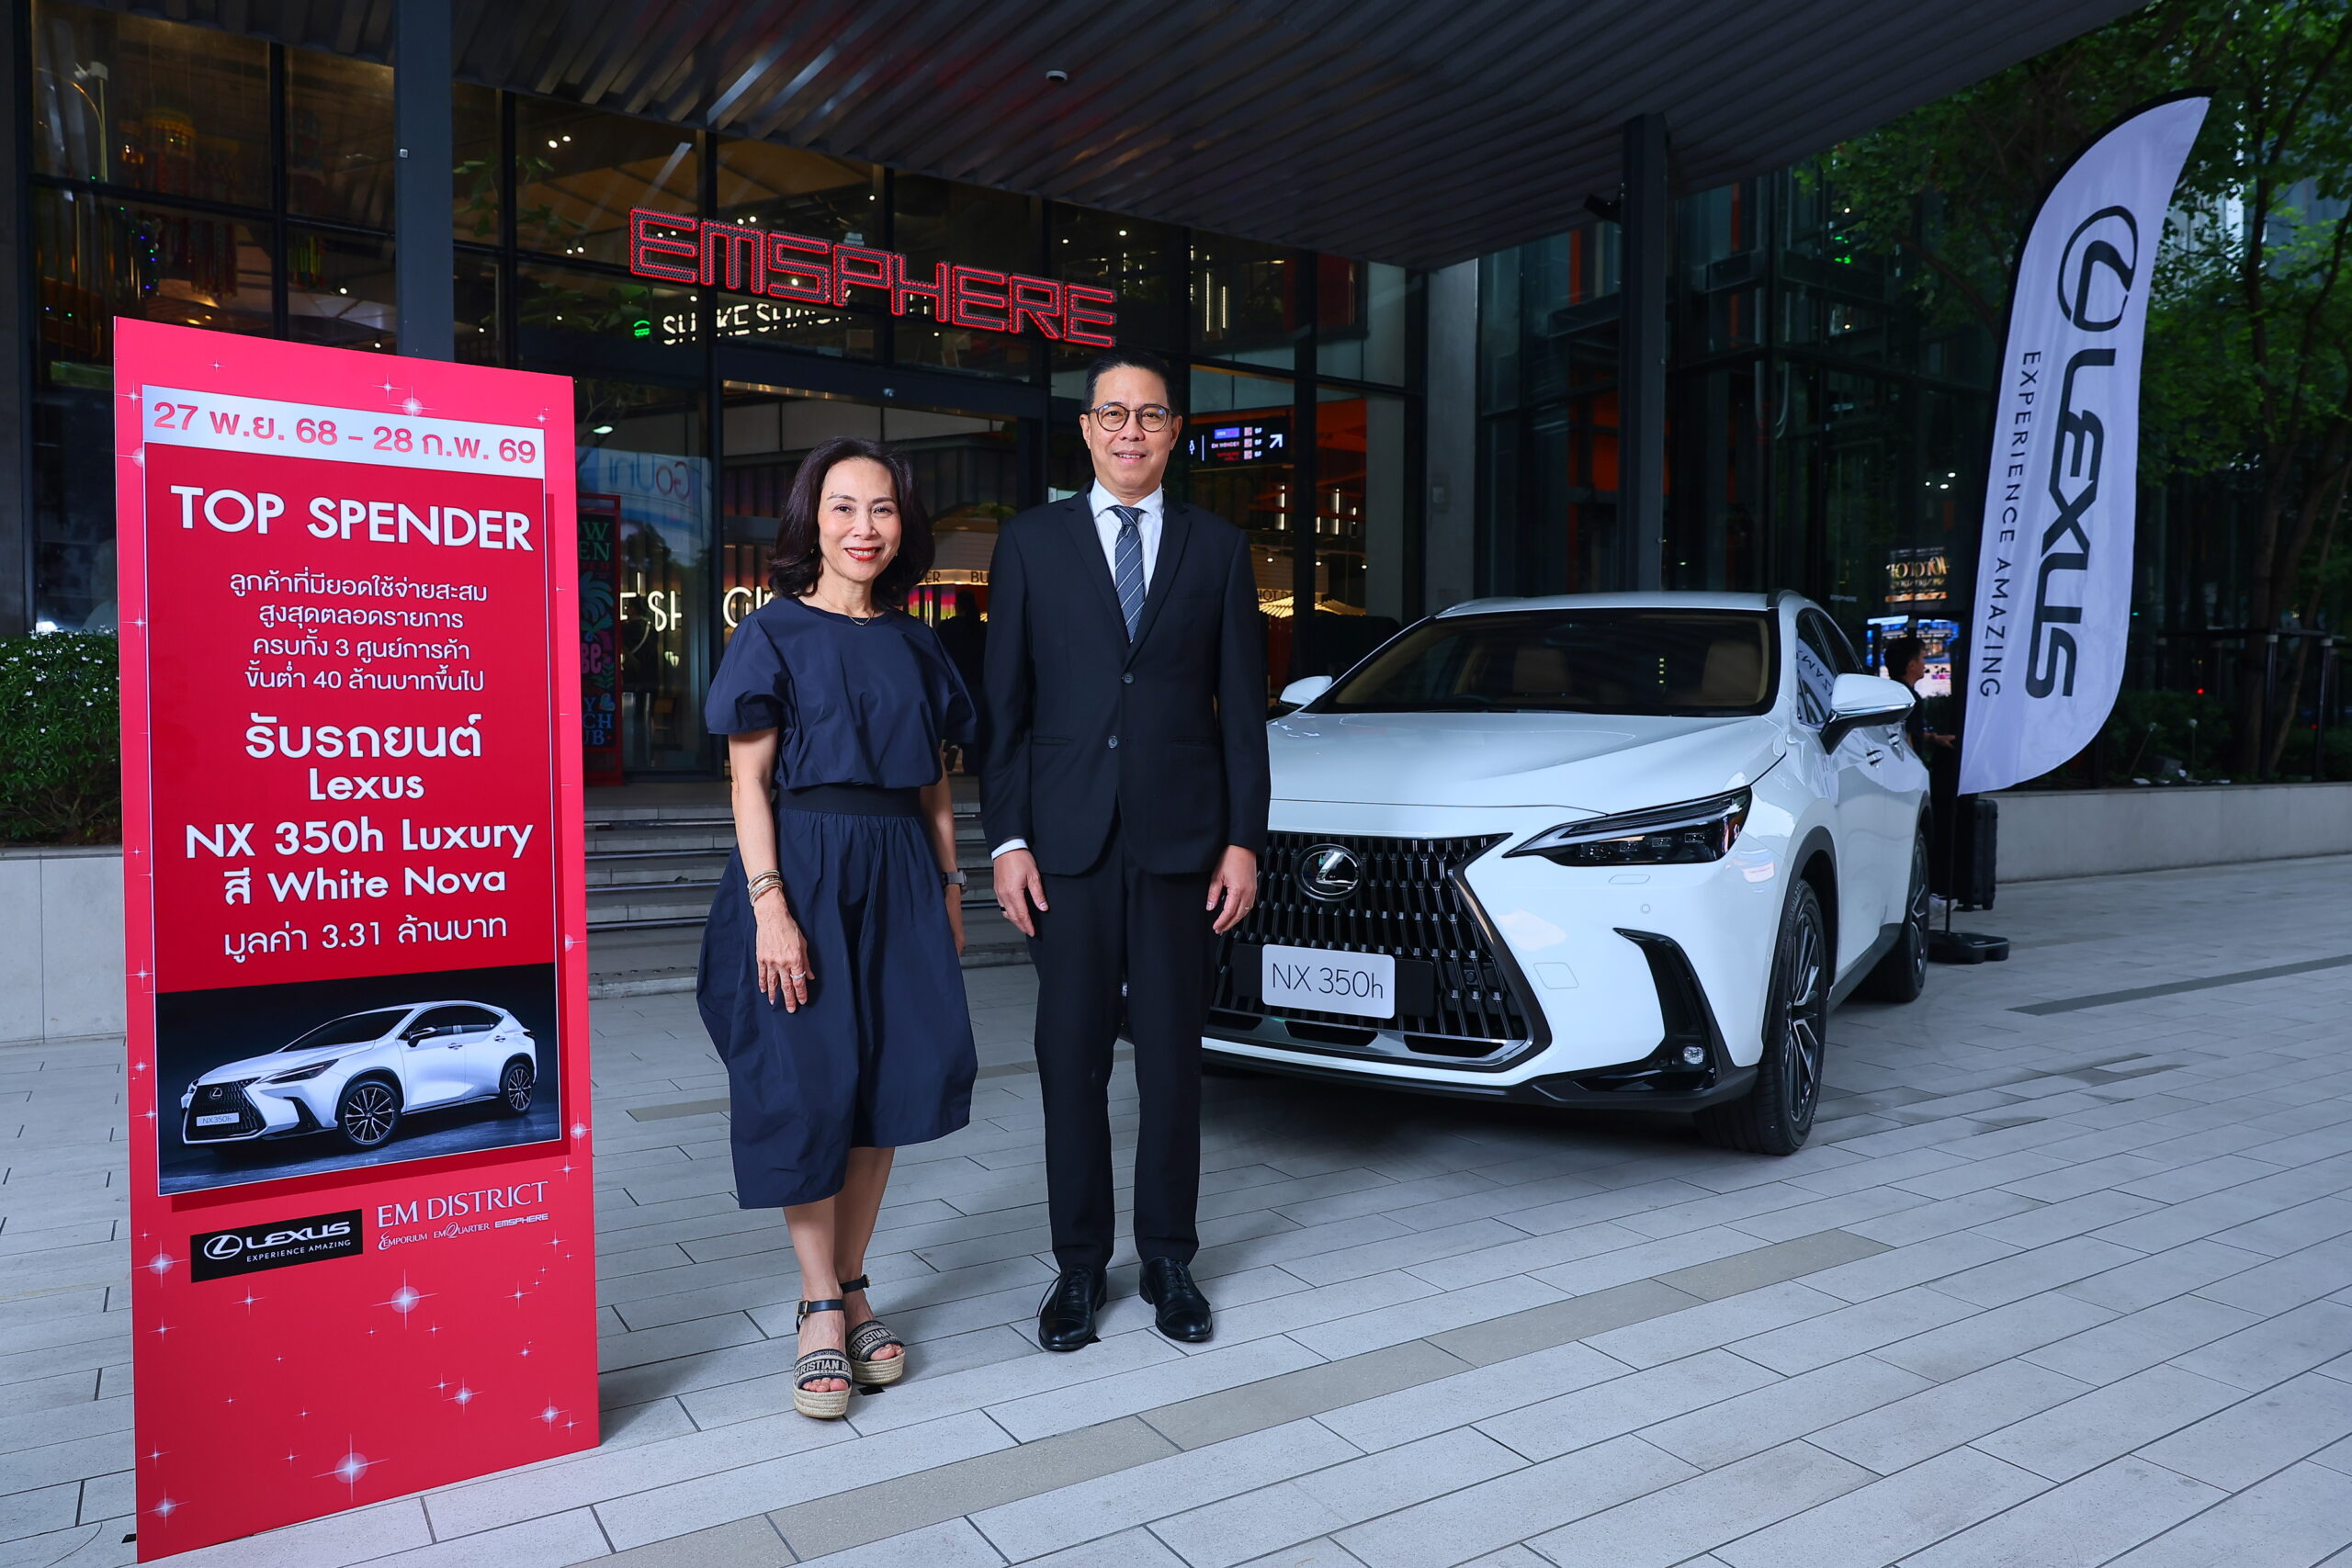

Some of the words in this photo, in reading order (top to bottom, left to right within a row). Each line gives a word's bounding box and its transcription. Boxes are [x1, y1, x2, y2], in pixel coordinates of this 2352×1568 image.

[628, 205, 1118, 348] EMSPHERE
[153, 400, 199, 431] 27
[209, 408, 285, 441] พ.ย.
[295, 418, 338, 446] 68
[372, 425, 414, 454] 28
[421, 434, 490, 460] ก.พ.
[498, 437, 537, 464] 69
[1997, 349, 2041, 545] EXPERIENCE
[170, 485, 286, 535] TOP
[306, 496, 534, 552] SPENDER
[2025, 347, 2117, 701] LEXUS
[229, 567, 488, 603] ลูกค้าที่มียอดใช้จ่ายสะสม
[257, 604, 464, 632] สูงสุดตลอดรายการ
[1978, 558, 2012, 699] AMAZING
[253, 628, 329, 658] ครบทั้ง
[335, 638, 350, 658] 3
[356, 637, 470, 664] ศูนย์การค้า
[244, 660, 306, 690] ขั้นต่ำ
[312, 668, 342, 689] 40
[348, 665, 484, 692] ล้านบาทขึ้นไป
[244, 711, 482, 760] รับรถยนต์
[308, 767, 425, 801] Lexus
[186, 822, 255, 859] NX
[274, 815, 385, 856] 350h
[401, 818, 535, 859] Luxury
[222, 866, 252, 907] สี
[266, 868, 390, 903] White
[404, 865, 507, 897] Nova
[223, 920, 308, 964] มูลค่า
[322, 920, 380, 950] 3.31
[397, 914, 508, 945] ล้านบาท
[1272, 962, 1313, 993] NX
[1317, 966, 1384, 1000] 350h
[377, 1201, 420, 1229] EM
[425, 1179, 549, 1221] DISTRICT
[494, 1212, 549, 1230] EMSPHERE
[245, 1220, 352, 1249] LEXUS
[245, 1246, 306, 1264] EXPERIENCE
[308, 1238, 352, 1257] AMAZING
